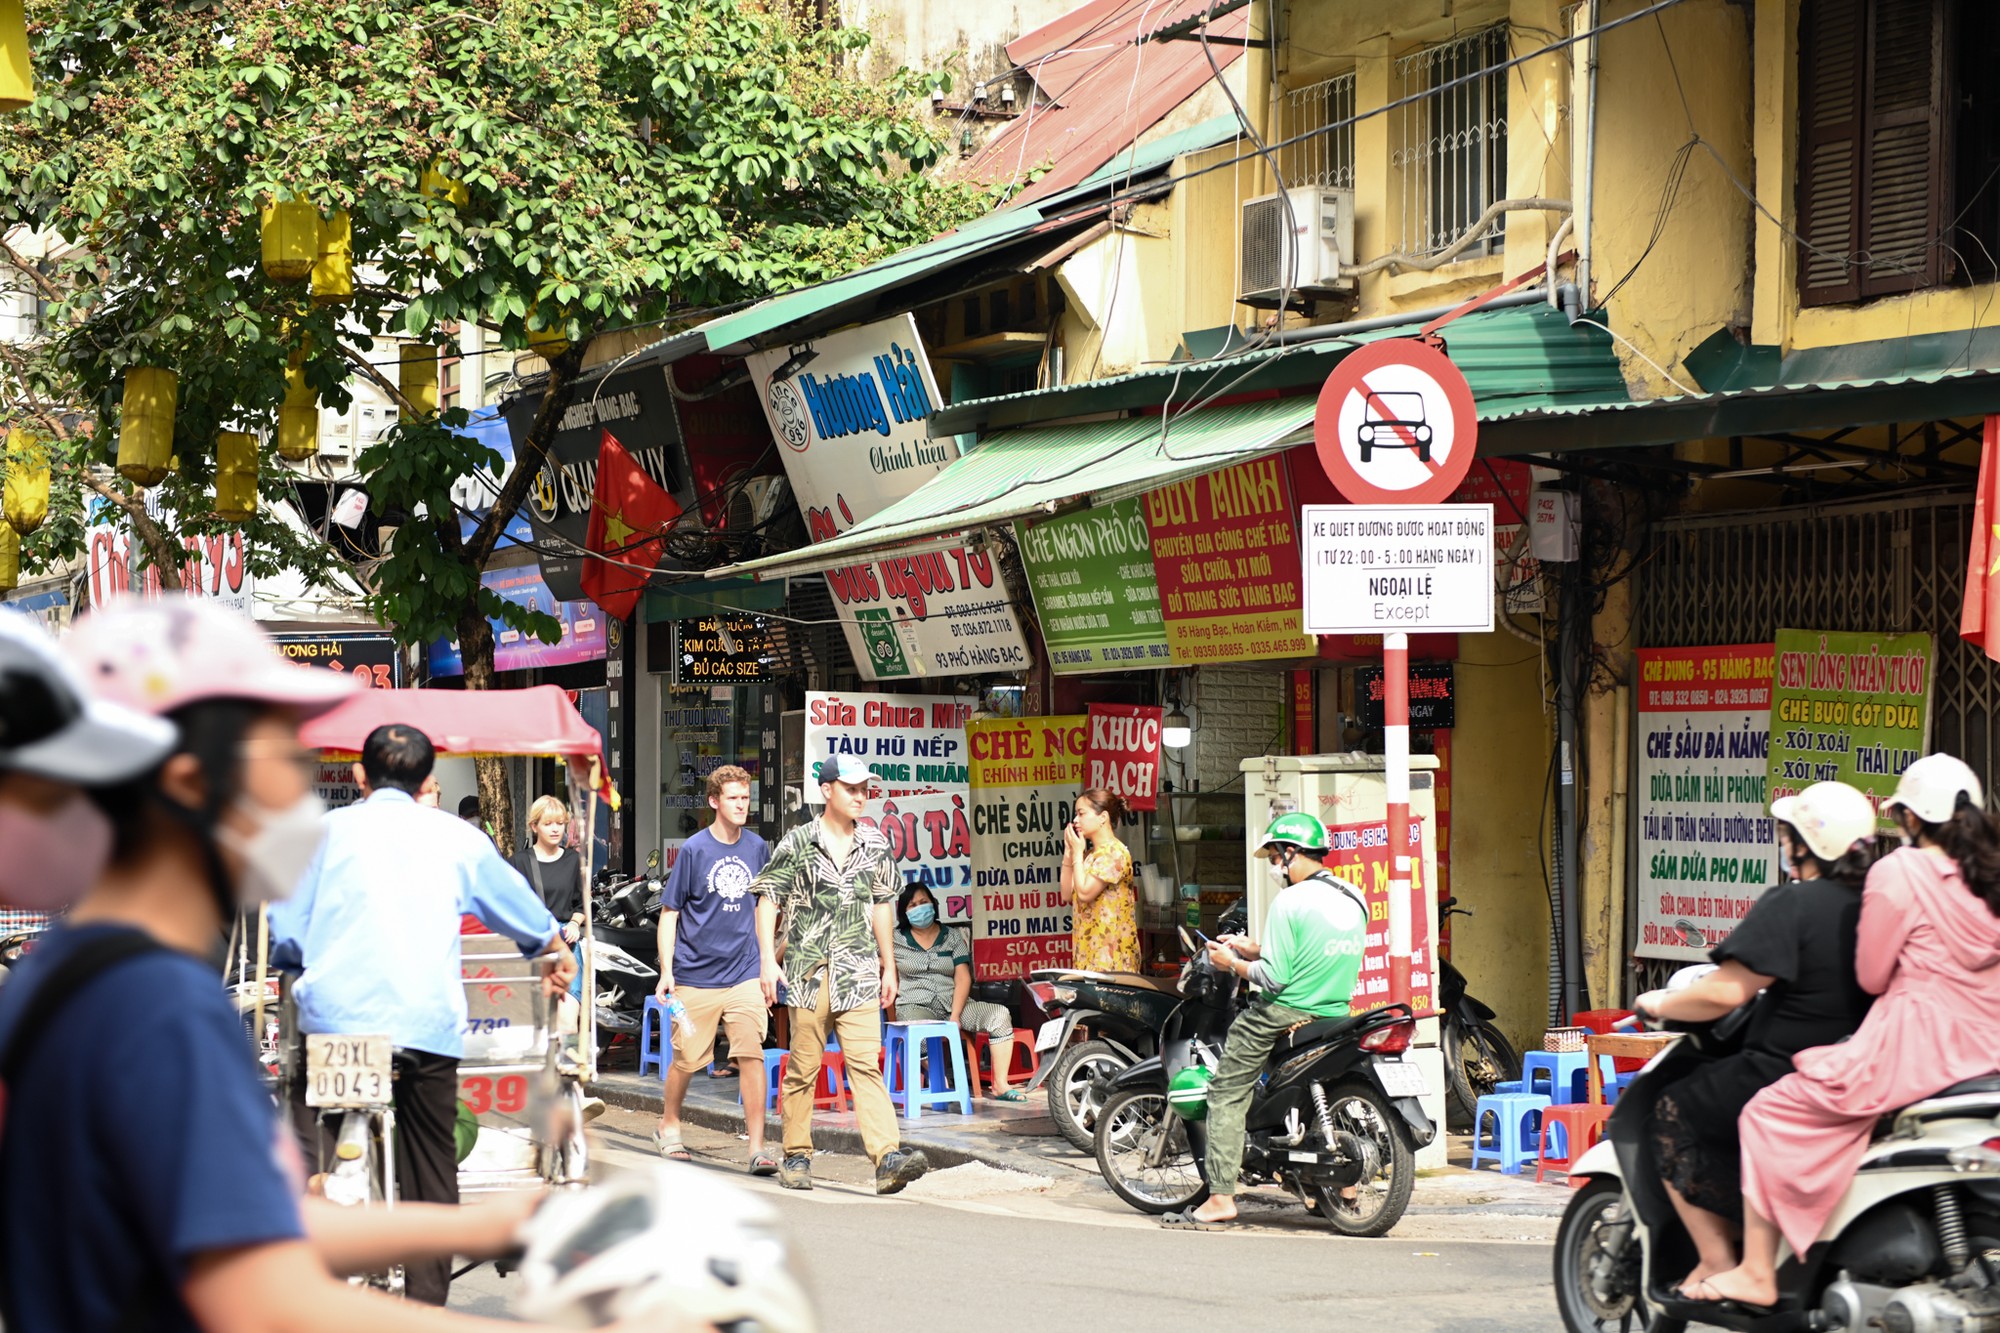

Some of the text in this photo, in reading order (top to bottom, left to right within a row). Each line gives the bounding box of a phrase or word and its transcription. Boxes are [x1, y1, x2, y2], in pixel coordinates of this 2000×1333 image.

[798, 372, 891, 440] Hương
[874, 342, 933, 424] Hải
[781, 418, 806, 442] 1986
[869, 441, 913, 474] Chính
[1208, 459, 1284, 520] MINH
[1154, 532, 1195, 559] CHUYÊN
[1195, 535, 1214, 556] GIA
[1214, 526, 1244, 552] CÔNG
[1268, 520, 1291, 545] TÁC
[1313, 522, 1326, 537] XE
[1024, 523, 1055, 564] CHÈ
[1050, 522, 1097, 563] NGON
[1235, 558, 1249, 579] XI
[1249, 551, 1272, 577] MỚI
[1183, 590, 1219, 612] TRANG
[1219, 583, 1241, 609] SỨC
[1241, 581, 1272, 608] VÀNG
[1273, 581, 1296, 608] BẠC
[1369, 573, 1433, 600] NGOẠI LỆ
[1373, 602, 1430, 623] Except
[1177, 626, 1188, 639] 95
[1189, 624, 1211, 640] Hàng
[1232, 619, 1256, 636] Hoàn
[1283, 617, 1298, 631] HN
[320, 641, 343, 656] HẢI
[935, 644, 1024, 669] 93 PHỐ HÀNG BẠC
[1176, 646, 1193, 659] Tel:
[693, 657, 760, 676] ĐỦ CÁC SIZE
[1643, 655, 1663, 682] CHÈ
[1663, 659, 1695, 682] DUNG
[1702, 658, 1717, 681] 95
[1719, 652, 1752, 680] HÀNG
[1779, 651, 1808, 689] SEN
[1026, 692, 1040, 713] 93
[1295, 683, 1310, 701] 95
[810, 697, 973, 729] Sữa Chua Mít
[1778, 694, 1920, 730] CHÈ BƯỞI CỐT DỪA
[970, 721, 1088, 761] CHÈ NG
[1090, 708, 1158, 753] KHÚC
[1674, 718, 1703, 759] SẦU
[1784, 727, 1850, 753] XÔI XOÀI
[826, 733, 958, 758] TÀU HŨ NẾP
[1782, 757, 1810, 780] XÔI
[1855, 742, 1889, 775] THÁI
[983, 761, 1066, 785] CHÍNH HIỆU
[974, 789, 1051, 836] CHÈ SẦU
[1334, 828, 1374, 850] DUNG 95
[976, 863, 1051, 887] DỪA DẦM
[1650, 848, 1768, 885] SÂM DỨA PHO MAI
[722, 903, 741, 912] BYU
[983, 890, 1014, 912] TÀU
[1020, 889, 1041, 910] HŨ
[1677, 896, 1697, 917] CHUA
[987, 916, 1058, 936] PHO MAI
[1006, 940, 1040, 957] SỮA
[1323, 938, 1362, 956] Grab
[980, 957, 1023, 977] TRÂN
[323, 1041, 376, 1067] 29XL
[316, 1071, 382, 1098] 0043
[461, 1074, 529, 1115] 39
